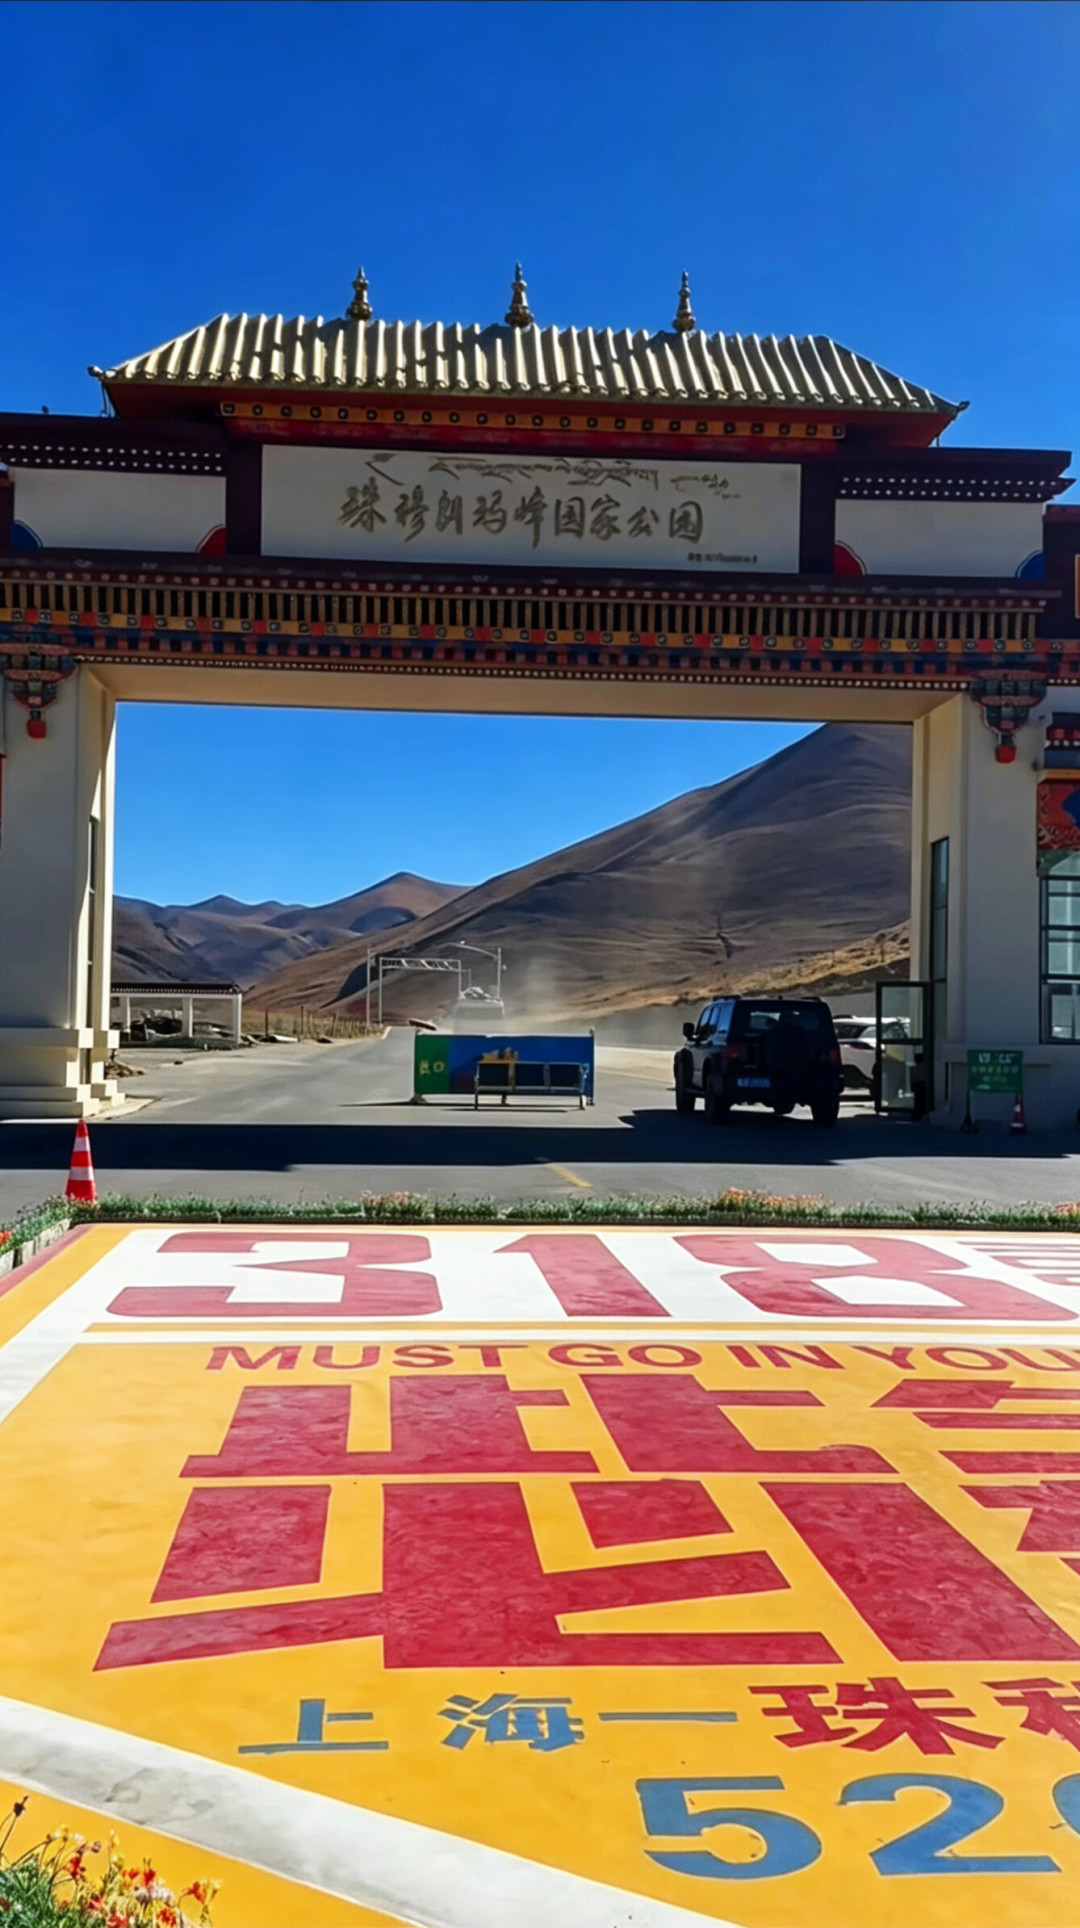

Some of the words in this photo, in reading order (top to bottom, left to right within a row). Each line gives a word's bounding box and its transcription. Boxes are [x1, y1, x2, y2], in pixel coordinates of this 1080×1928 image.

[338, 476, 705, 549] 珠穆朗玛峰国家公园
[107, 1232, 1080, 1321] 318
[206, 1345, 528, 1371] MUST
[549, 1344, 703, 1369] GO
[726, 1345, 846, 1370] IN
[850, 1346, 1080, 1371] YOU
[635, 1772, 1080, 1880] 52
